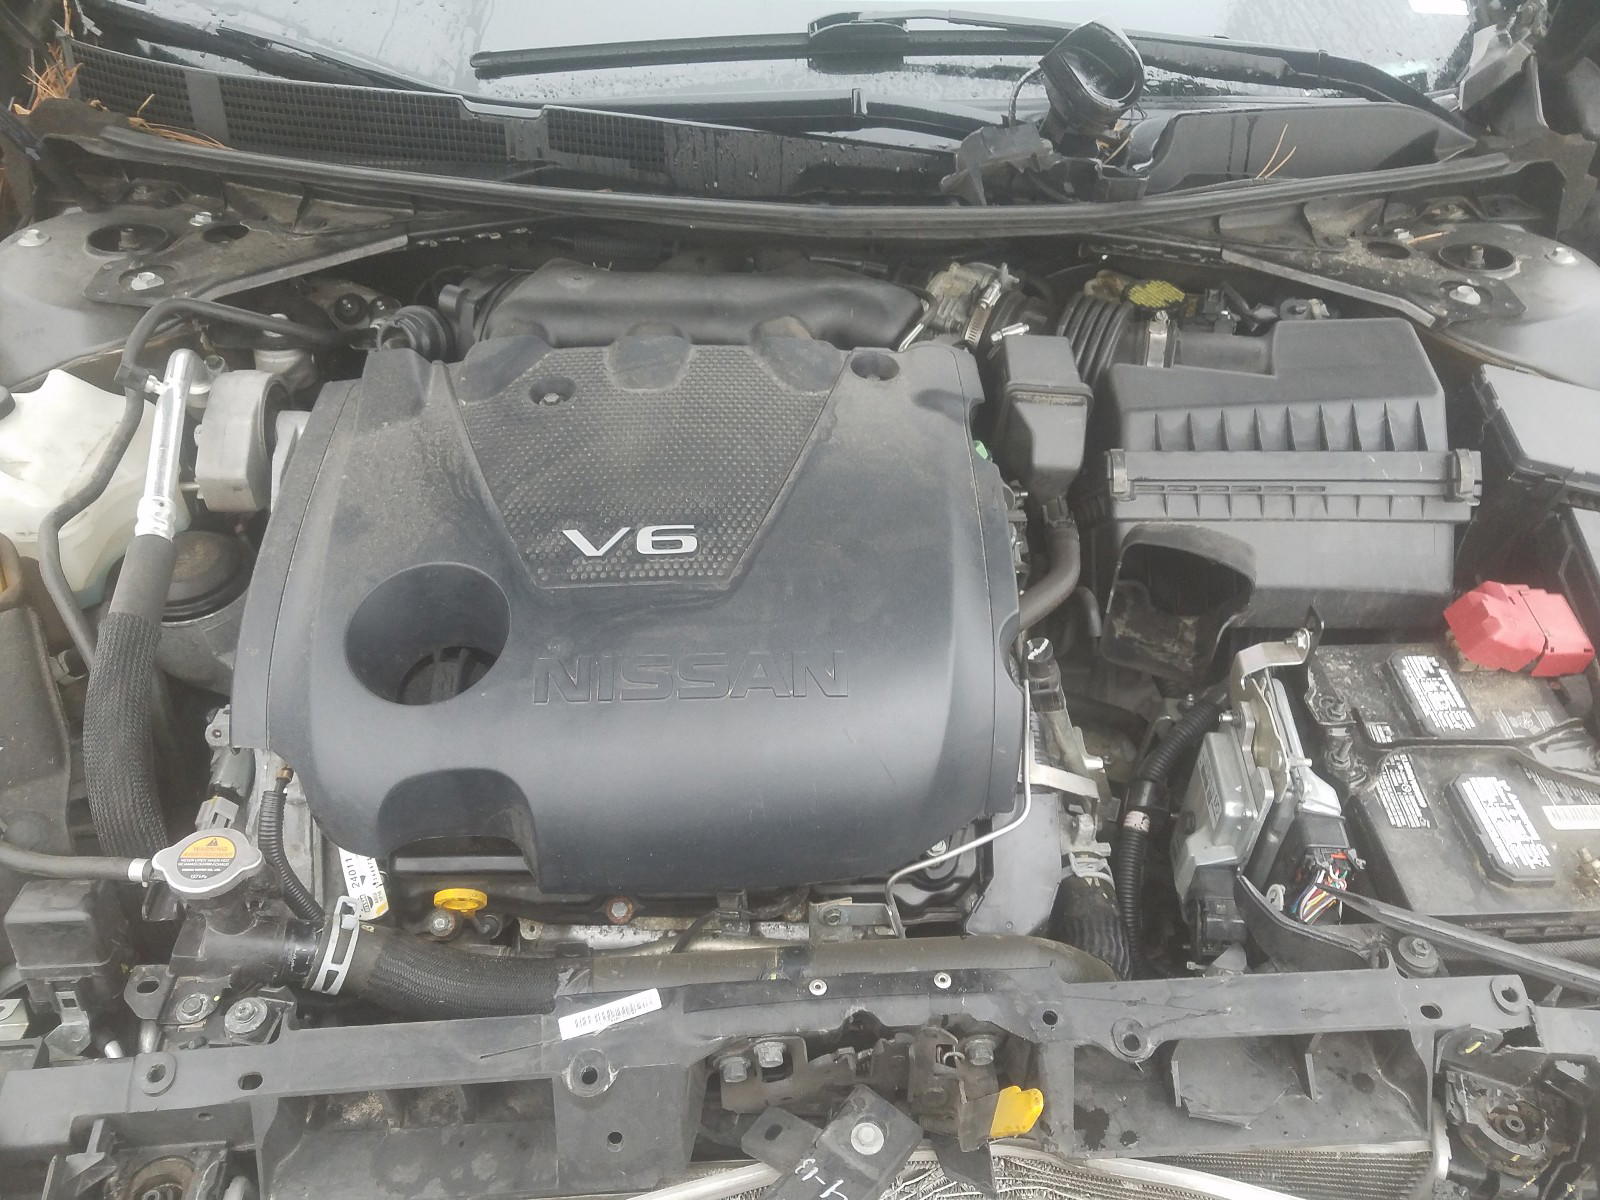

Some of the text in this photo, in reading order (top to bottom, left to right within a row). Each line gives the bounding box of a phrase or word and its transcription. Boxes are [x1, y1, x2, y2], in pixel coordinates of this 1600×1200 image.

[562, 524, 698, 557] V6
[532, 650, 849, 705] NISSAN
[345, 858, 361, 888] 24011
